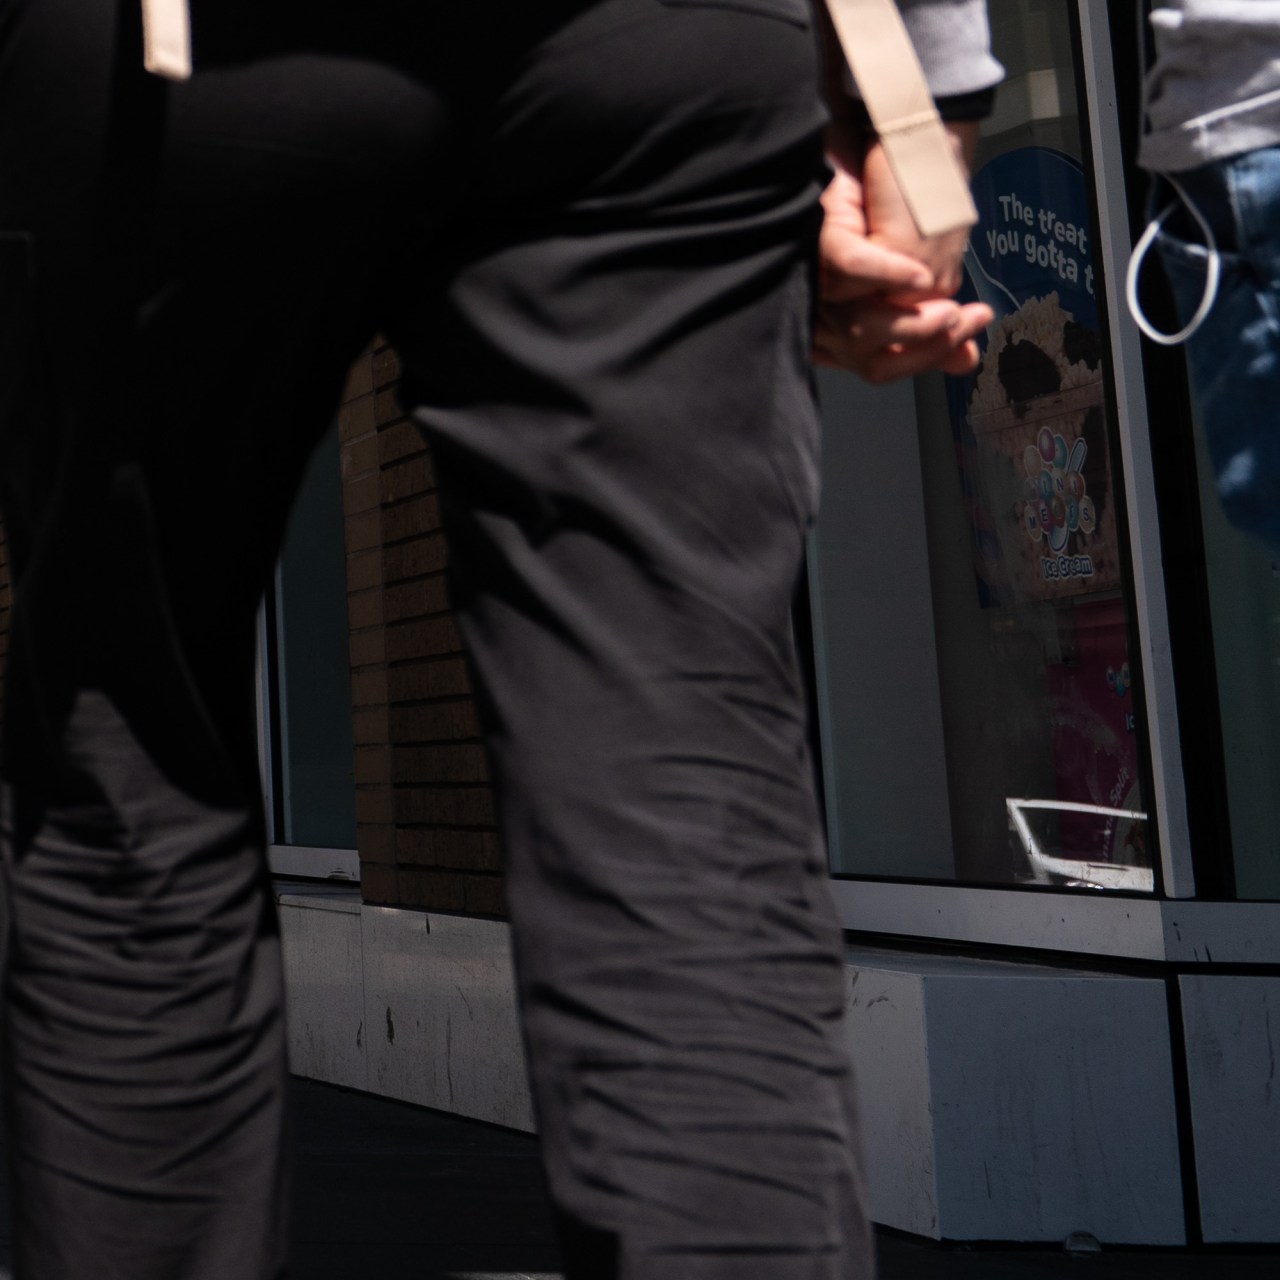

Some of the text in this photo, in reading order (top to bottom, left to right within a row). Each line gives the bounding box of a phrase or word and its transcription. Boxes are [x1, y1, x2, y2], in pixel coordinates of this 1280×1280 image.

[998, 192, 1087, 255] The treat
[1024, 233, 1078, 283] gotta
[1058, 555, 1093, 577] Cream
